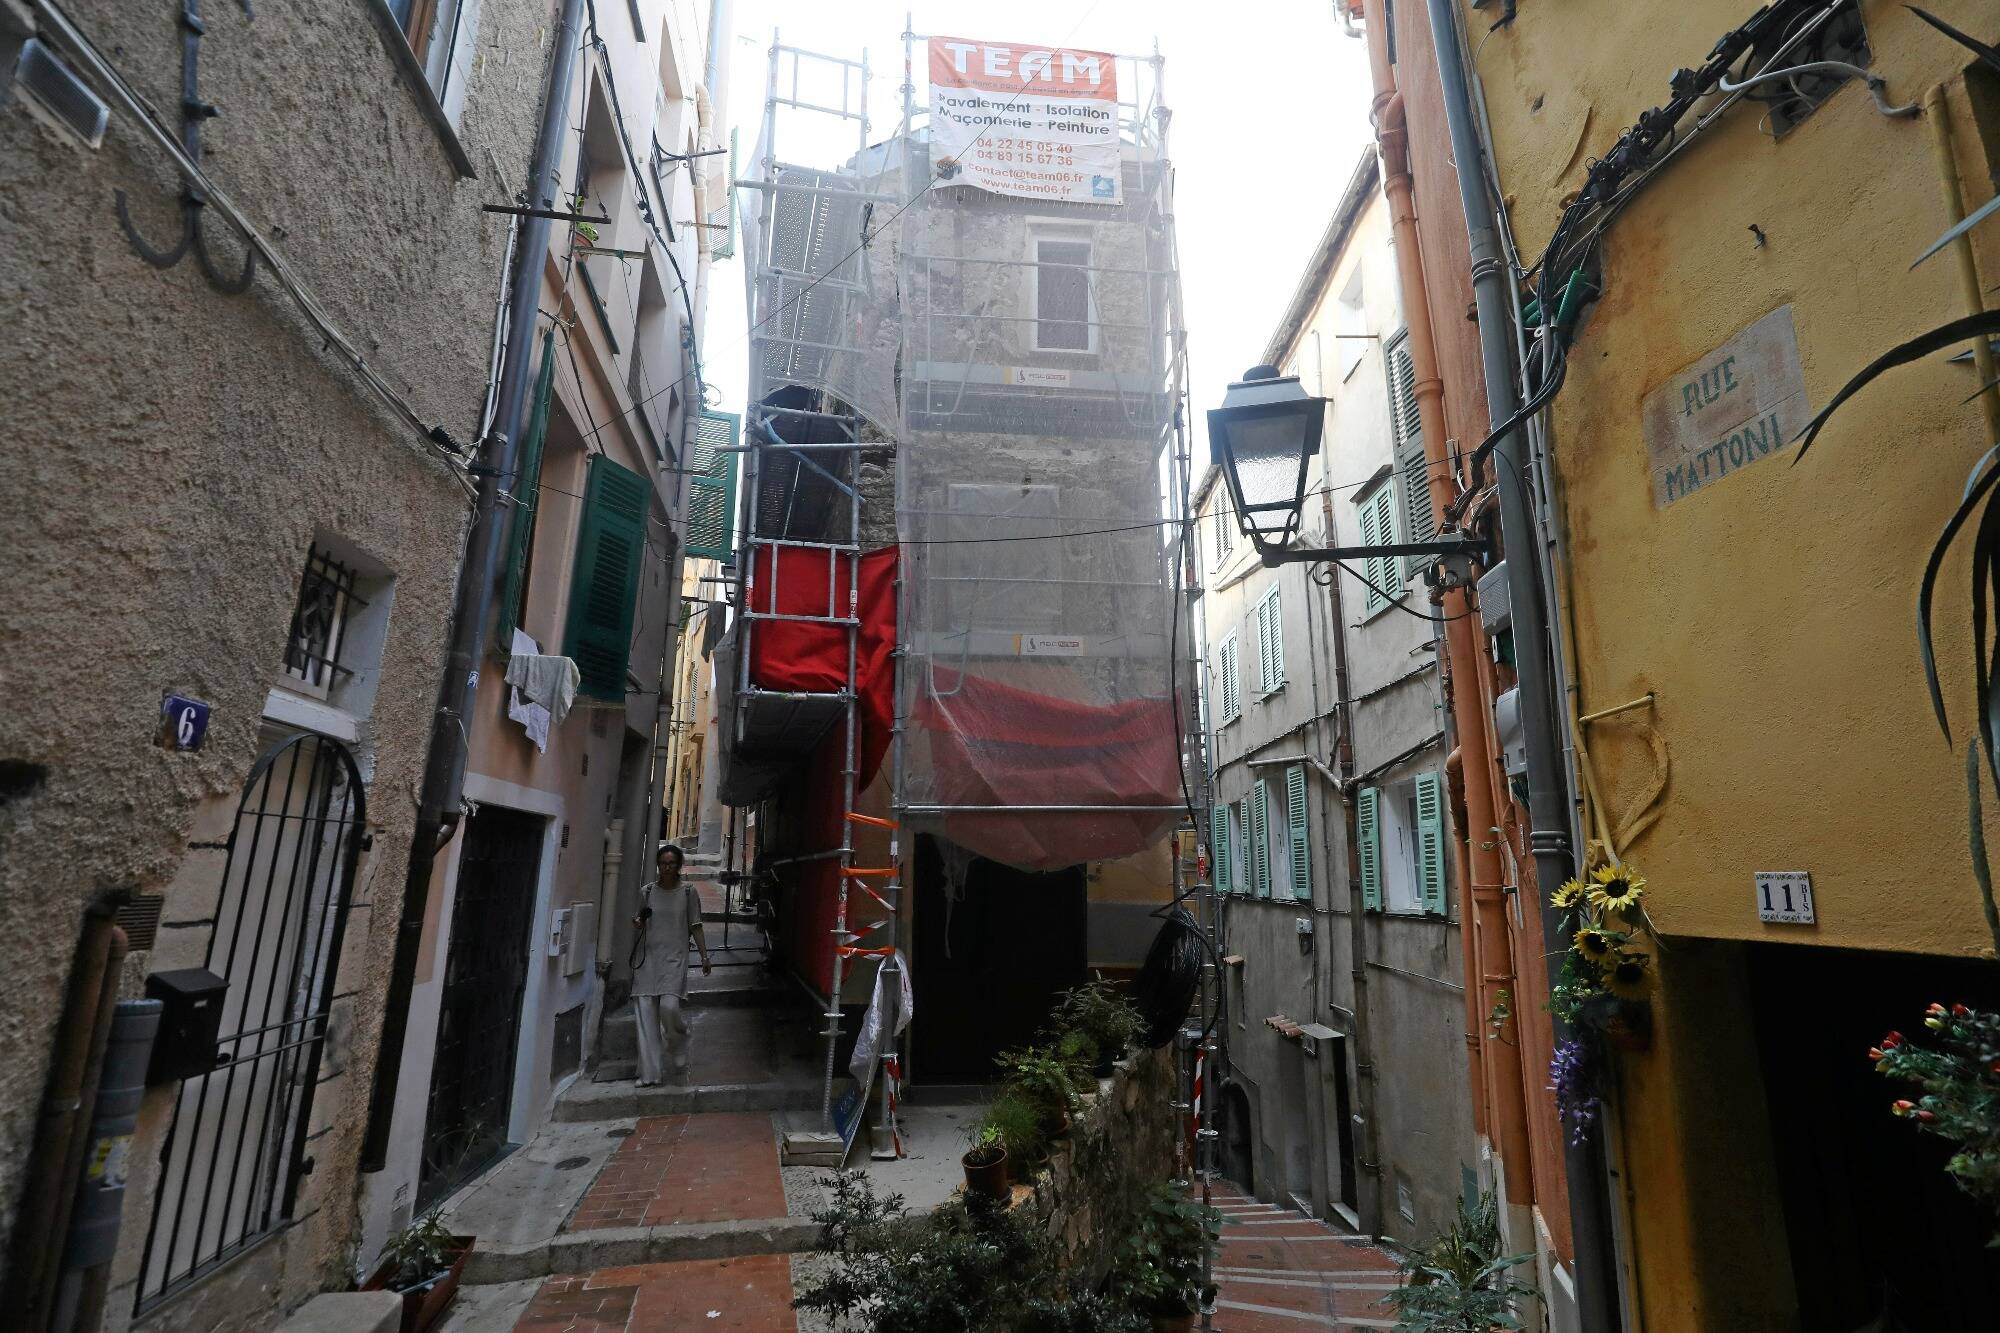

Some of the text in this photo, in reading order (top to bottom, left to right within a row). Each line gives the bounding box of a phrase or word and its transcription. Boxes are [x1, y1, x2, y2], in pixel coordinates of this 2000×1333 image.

[944, 42, 1101, 85] TEAM
[938, 105, 1032, 129] Maçonnerie
[1048, 119, 1110, 135] Peinture
[1046, 104, 1110, 120] Isolation
[976, 138, 1073, 154] 04 22 45 05 40
[977, 149, 993, 160] 04
[1018, 152, 1033, 163] 15
[1037, 154, 1053, 165] 67
[1057, 155, 1073, 166] 36
[968, 162, 1084, 183] contact@team06.fr
[981, 178, 1072, 195] www.team06.fr
[1681, 355, 1739, 417] RUE
[1665, 412, 1784, 502] MATTONI
[178, 706, 196, 747] 6
[1761, 883, 1796, 912] 11
[1801, 884, 1810, 912] BIS
